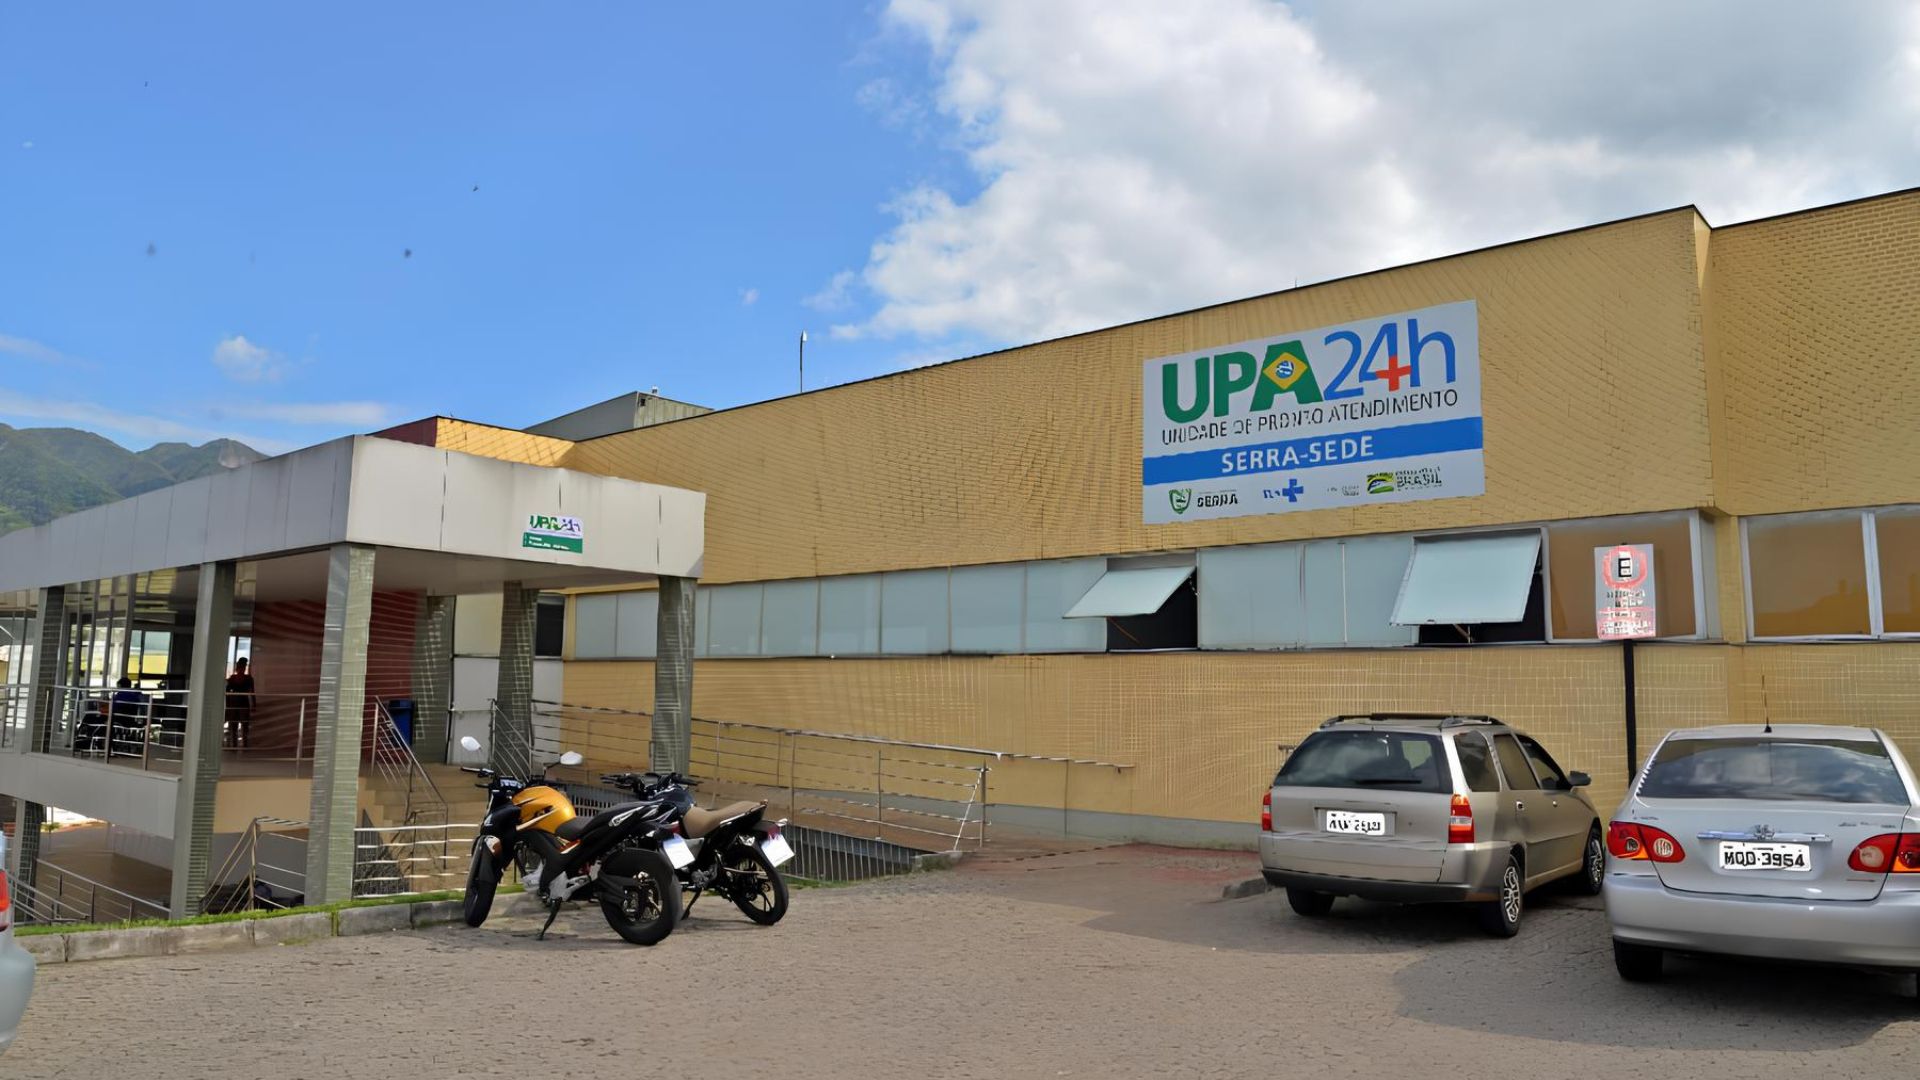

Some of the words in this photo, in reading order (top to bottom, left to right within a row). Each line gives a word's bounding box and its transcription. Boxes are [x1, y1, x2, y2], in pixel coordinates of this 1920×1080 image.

[1162, 340, 1323, 424] UPA
[1162, 421, 1227, 445] UNIDADE
[1233, 418, 1252, 435] DE
[1258, 408, 1323, 432] PRONTO
[1328, 389, 1458, 424] ATENDIMENTO
[1221, 435, 1375, 473] SERRA-SEDE
[1618, 557, 1633, 578] E
